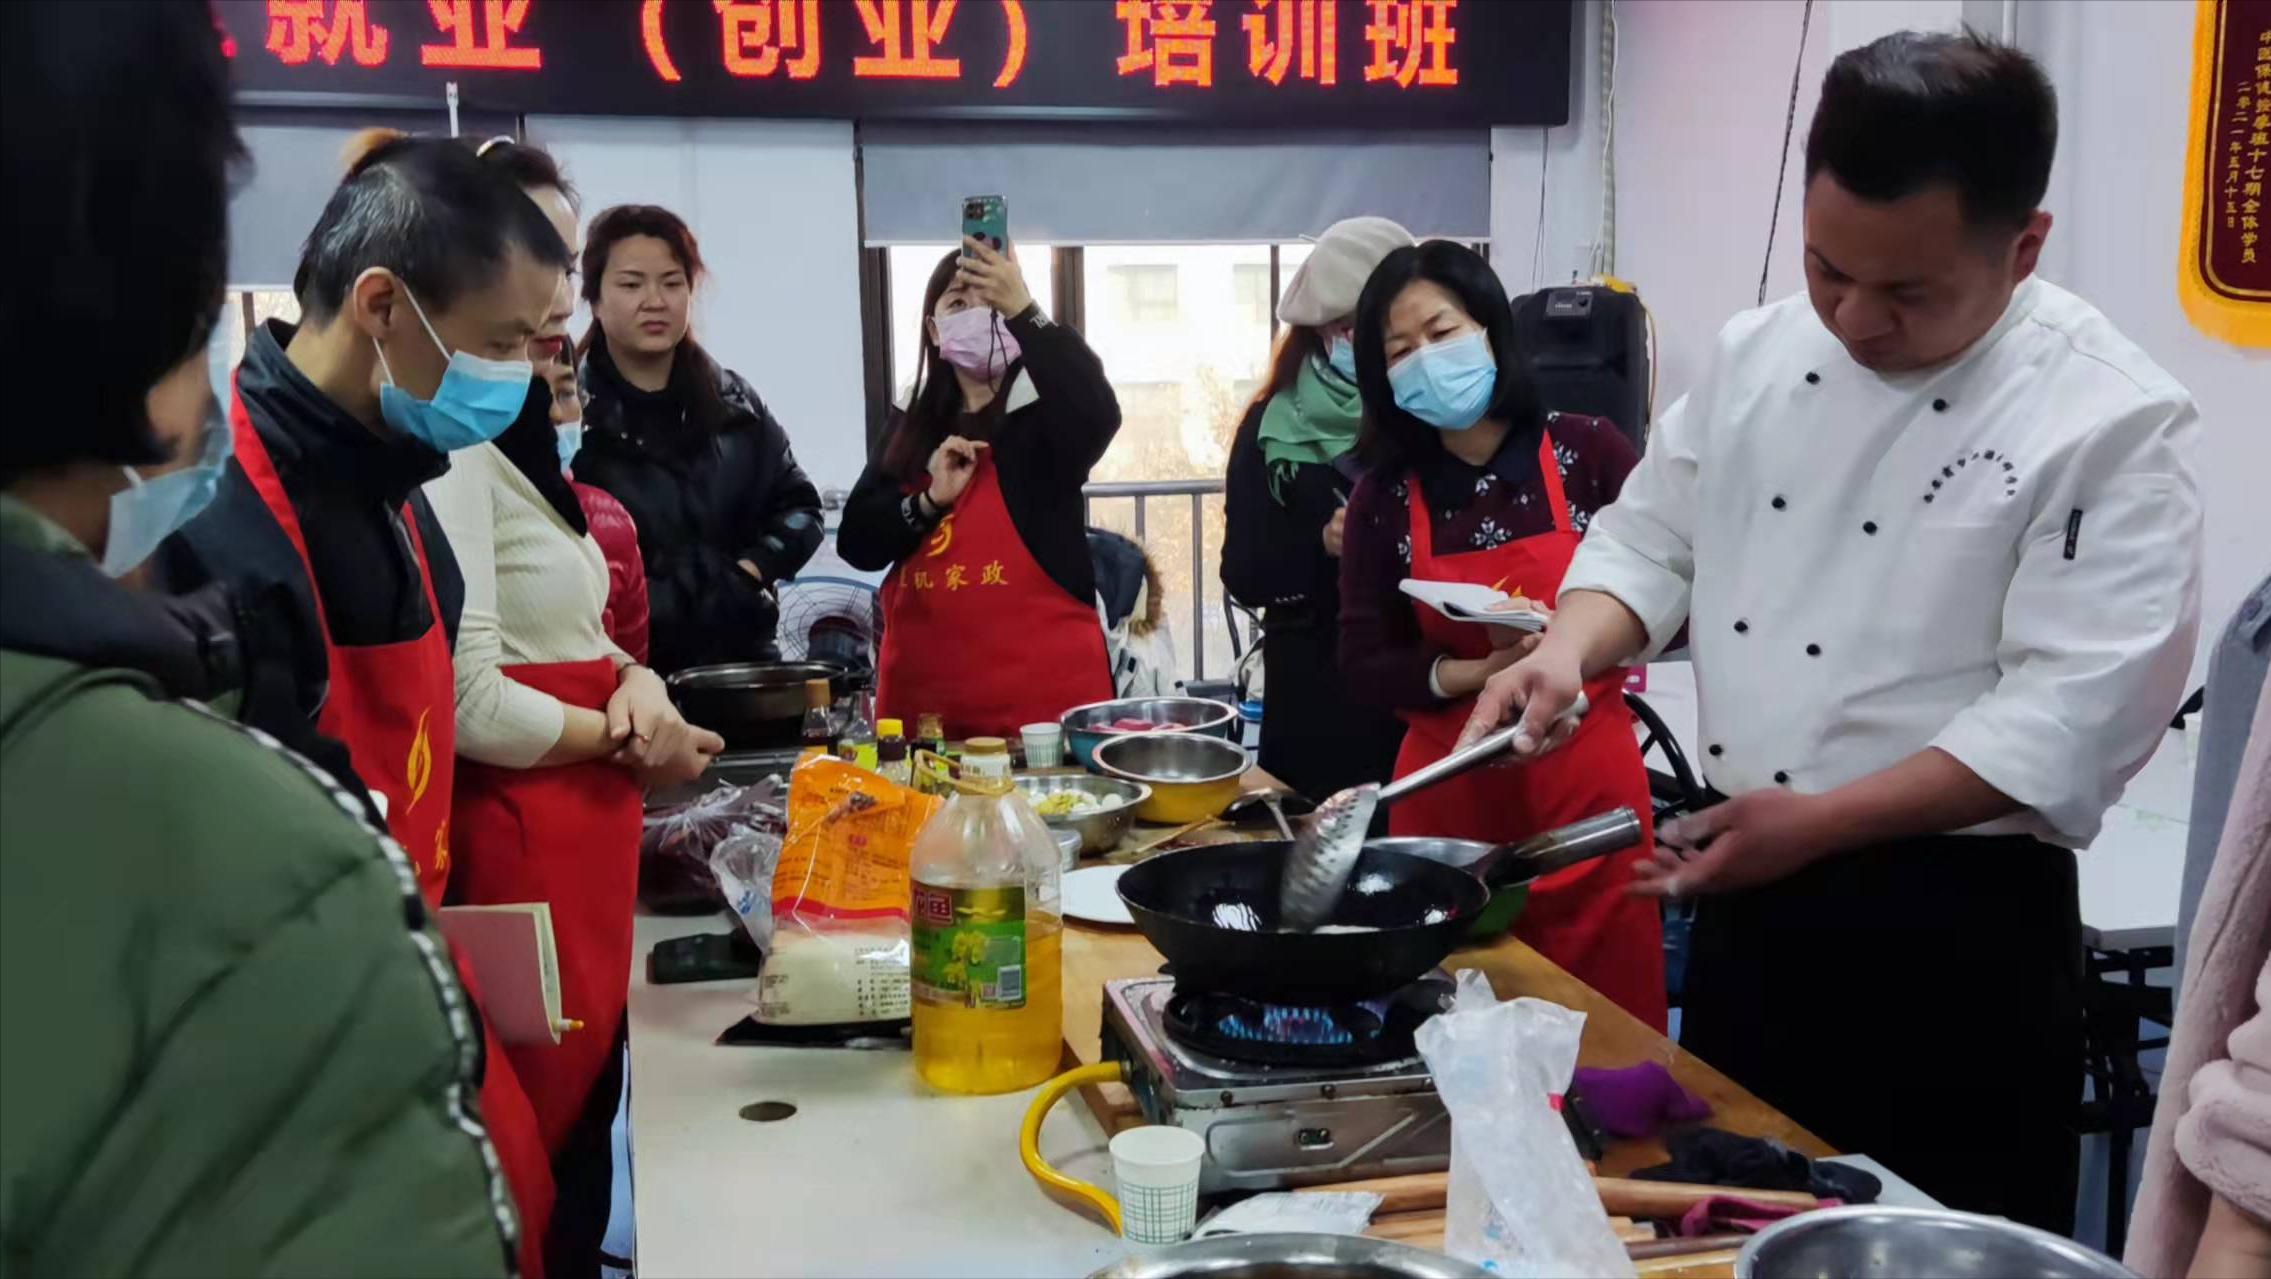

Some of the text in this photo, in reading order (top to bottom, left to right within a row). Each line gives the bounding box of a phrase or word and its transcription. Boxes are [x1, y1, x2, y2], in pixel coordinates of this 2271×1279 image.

[220, 0, 1460, 87] 就业（创业）培训班
